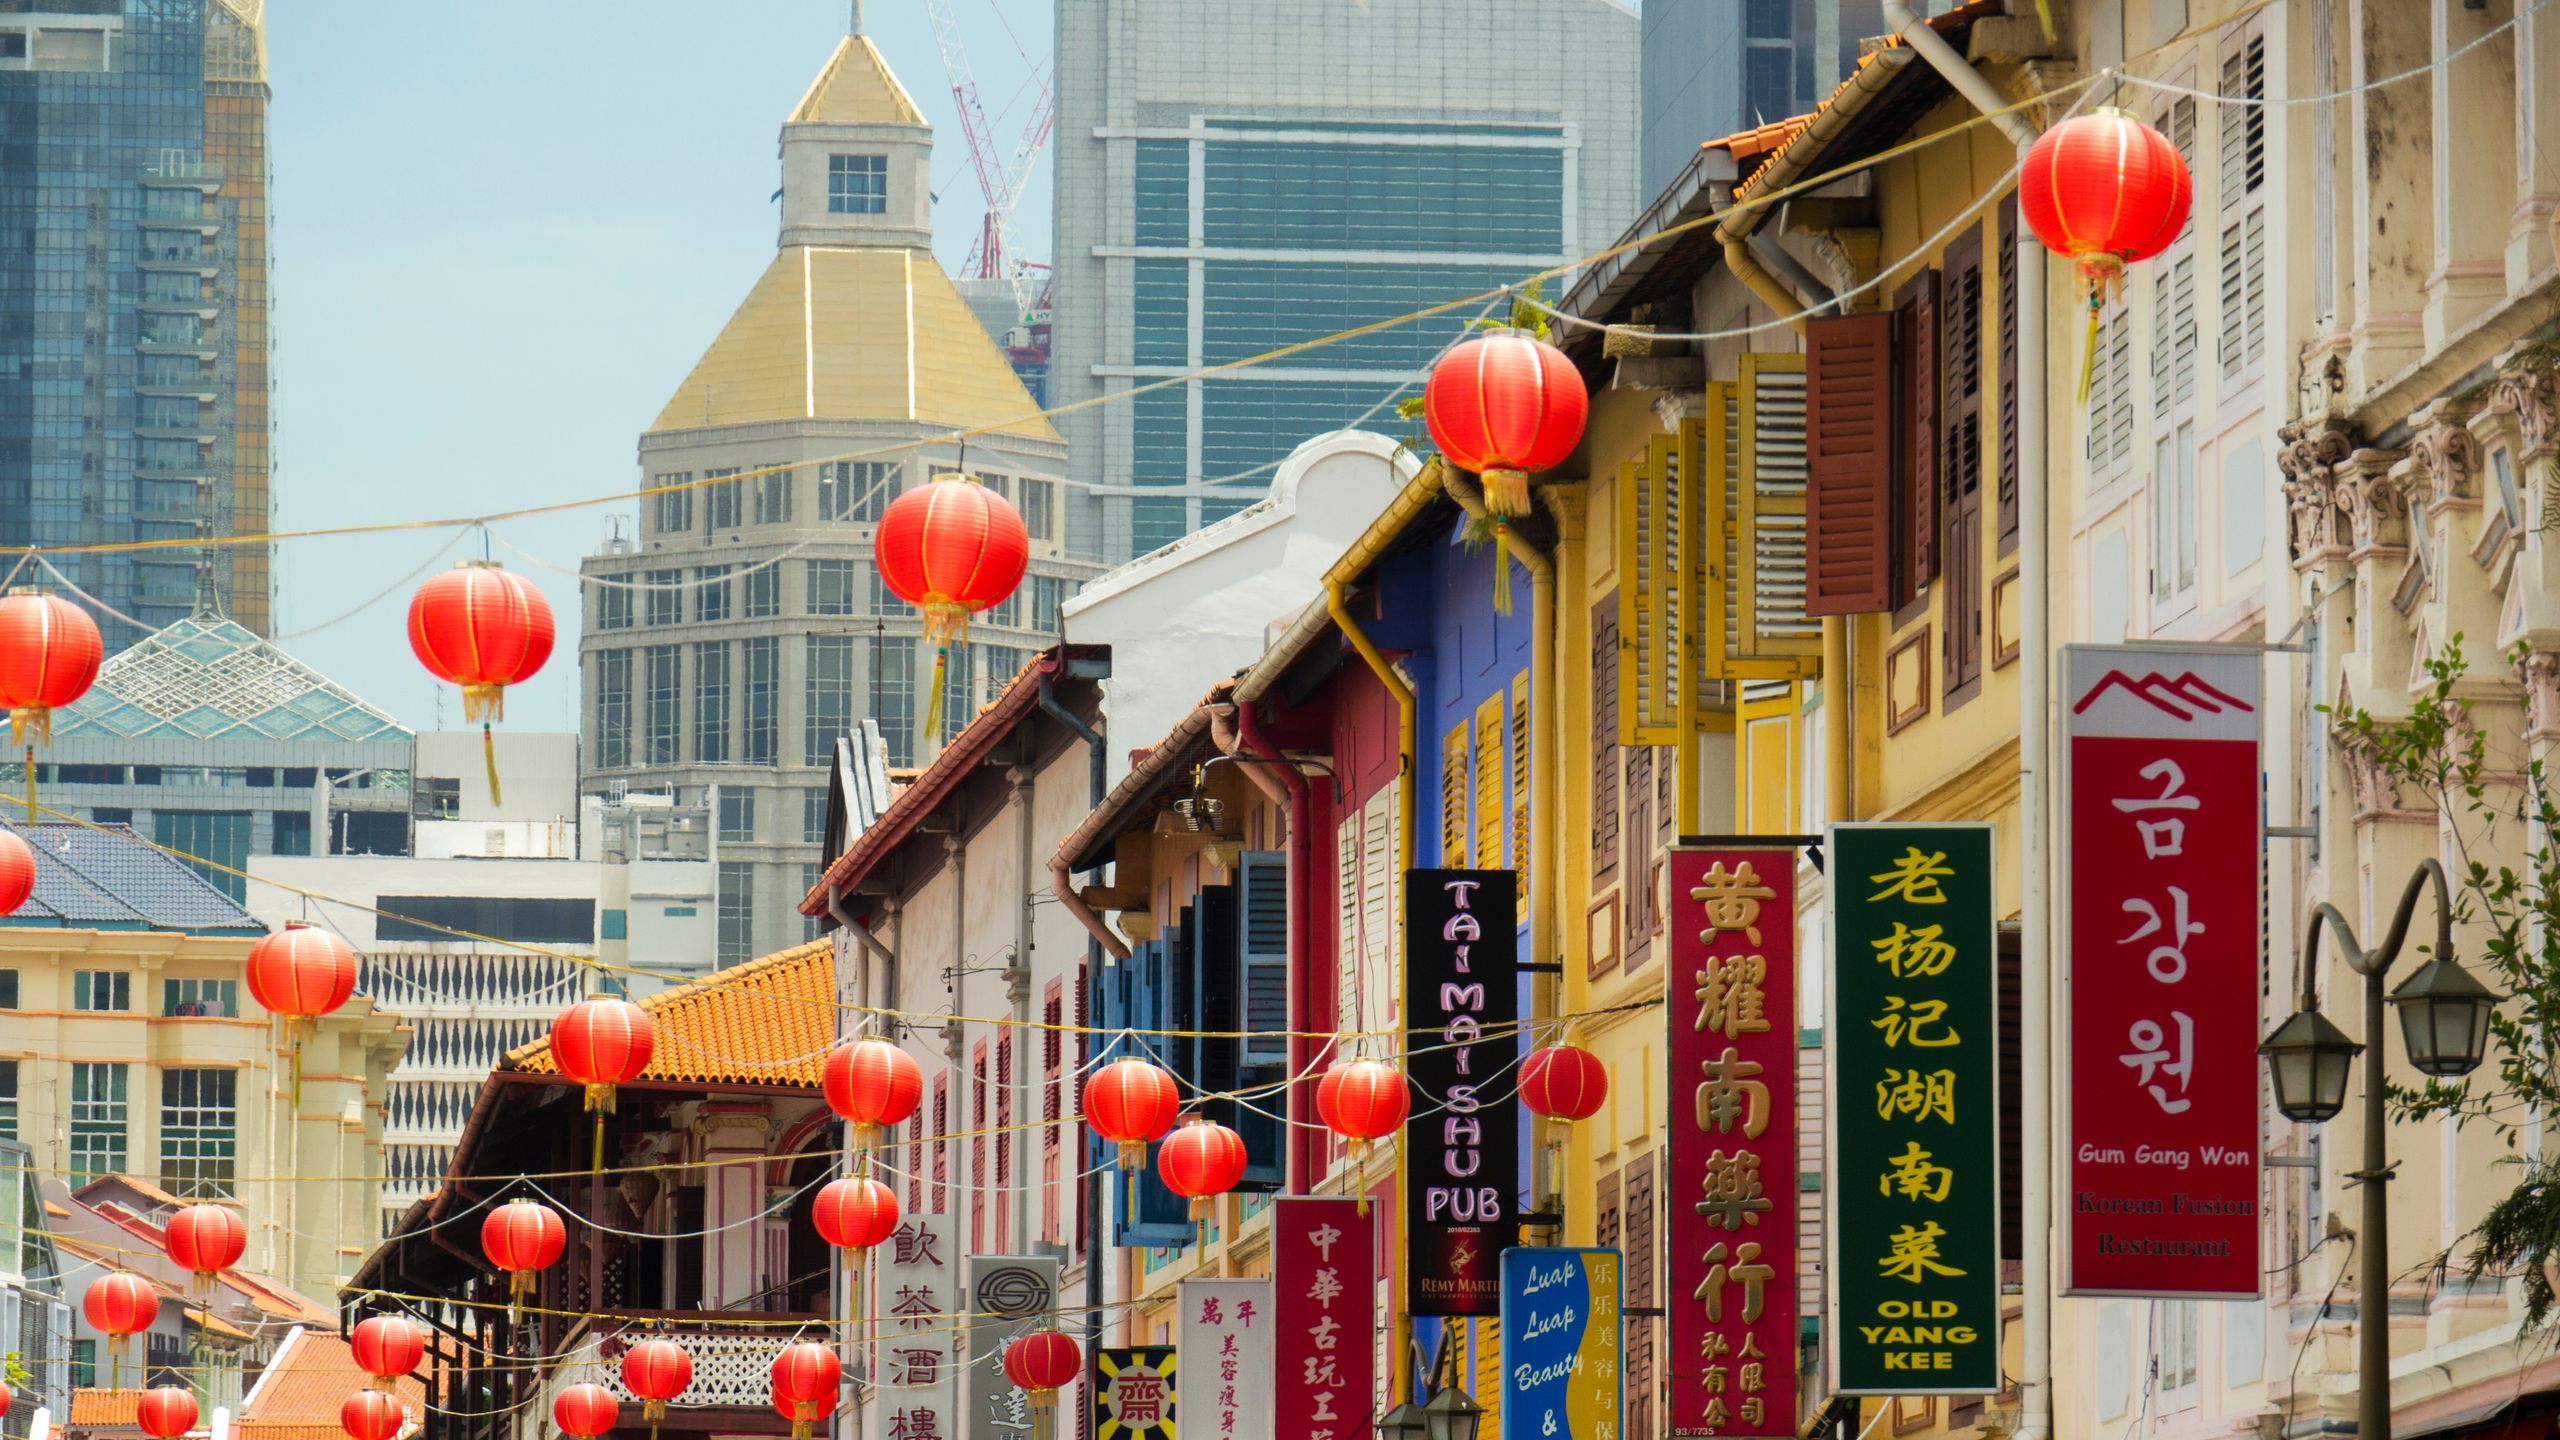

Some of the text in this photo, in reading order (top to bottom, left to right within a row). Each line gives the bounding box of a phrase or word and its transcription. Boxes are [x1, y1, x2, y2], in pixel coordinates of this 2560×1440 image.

[2111, 758, 2205, 1114] 금강원
[1867, 846, 1967, 1283] 老杨记湖南菜
[2078, 1143, 2250, 1170] Gum Gang Won
[1426, 1187, 1500, 1221] PUB
[2077, 1191, 2252, 1215] Korean Fusion
[2098, 1233, 2231, 1256] Restaurant
[1458, 1278, 1500, 1292] MARTI
[1523, 1260, 1576, 1296] Luap
[1523, 1305, 1576, 1341] Luap
[1878, 1301, 1958, 1319] OLD
[888, 1221, 944, 1440] 飲茶酒樓
[1859, 1326, 1978, 1344] YANG
[1594, 1263, 1614, 1440] 乐乐美容与保
[1885, 1351, 1953, 1370] KEE
[1219, 1334, 1239, 1440] 美容瘦身
[1514, 1353, 1585, 1391] Beauty
[1542, 1408, 1557, 1437] &
[1675, 1427, 1715, 1436] 93/7735
